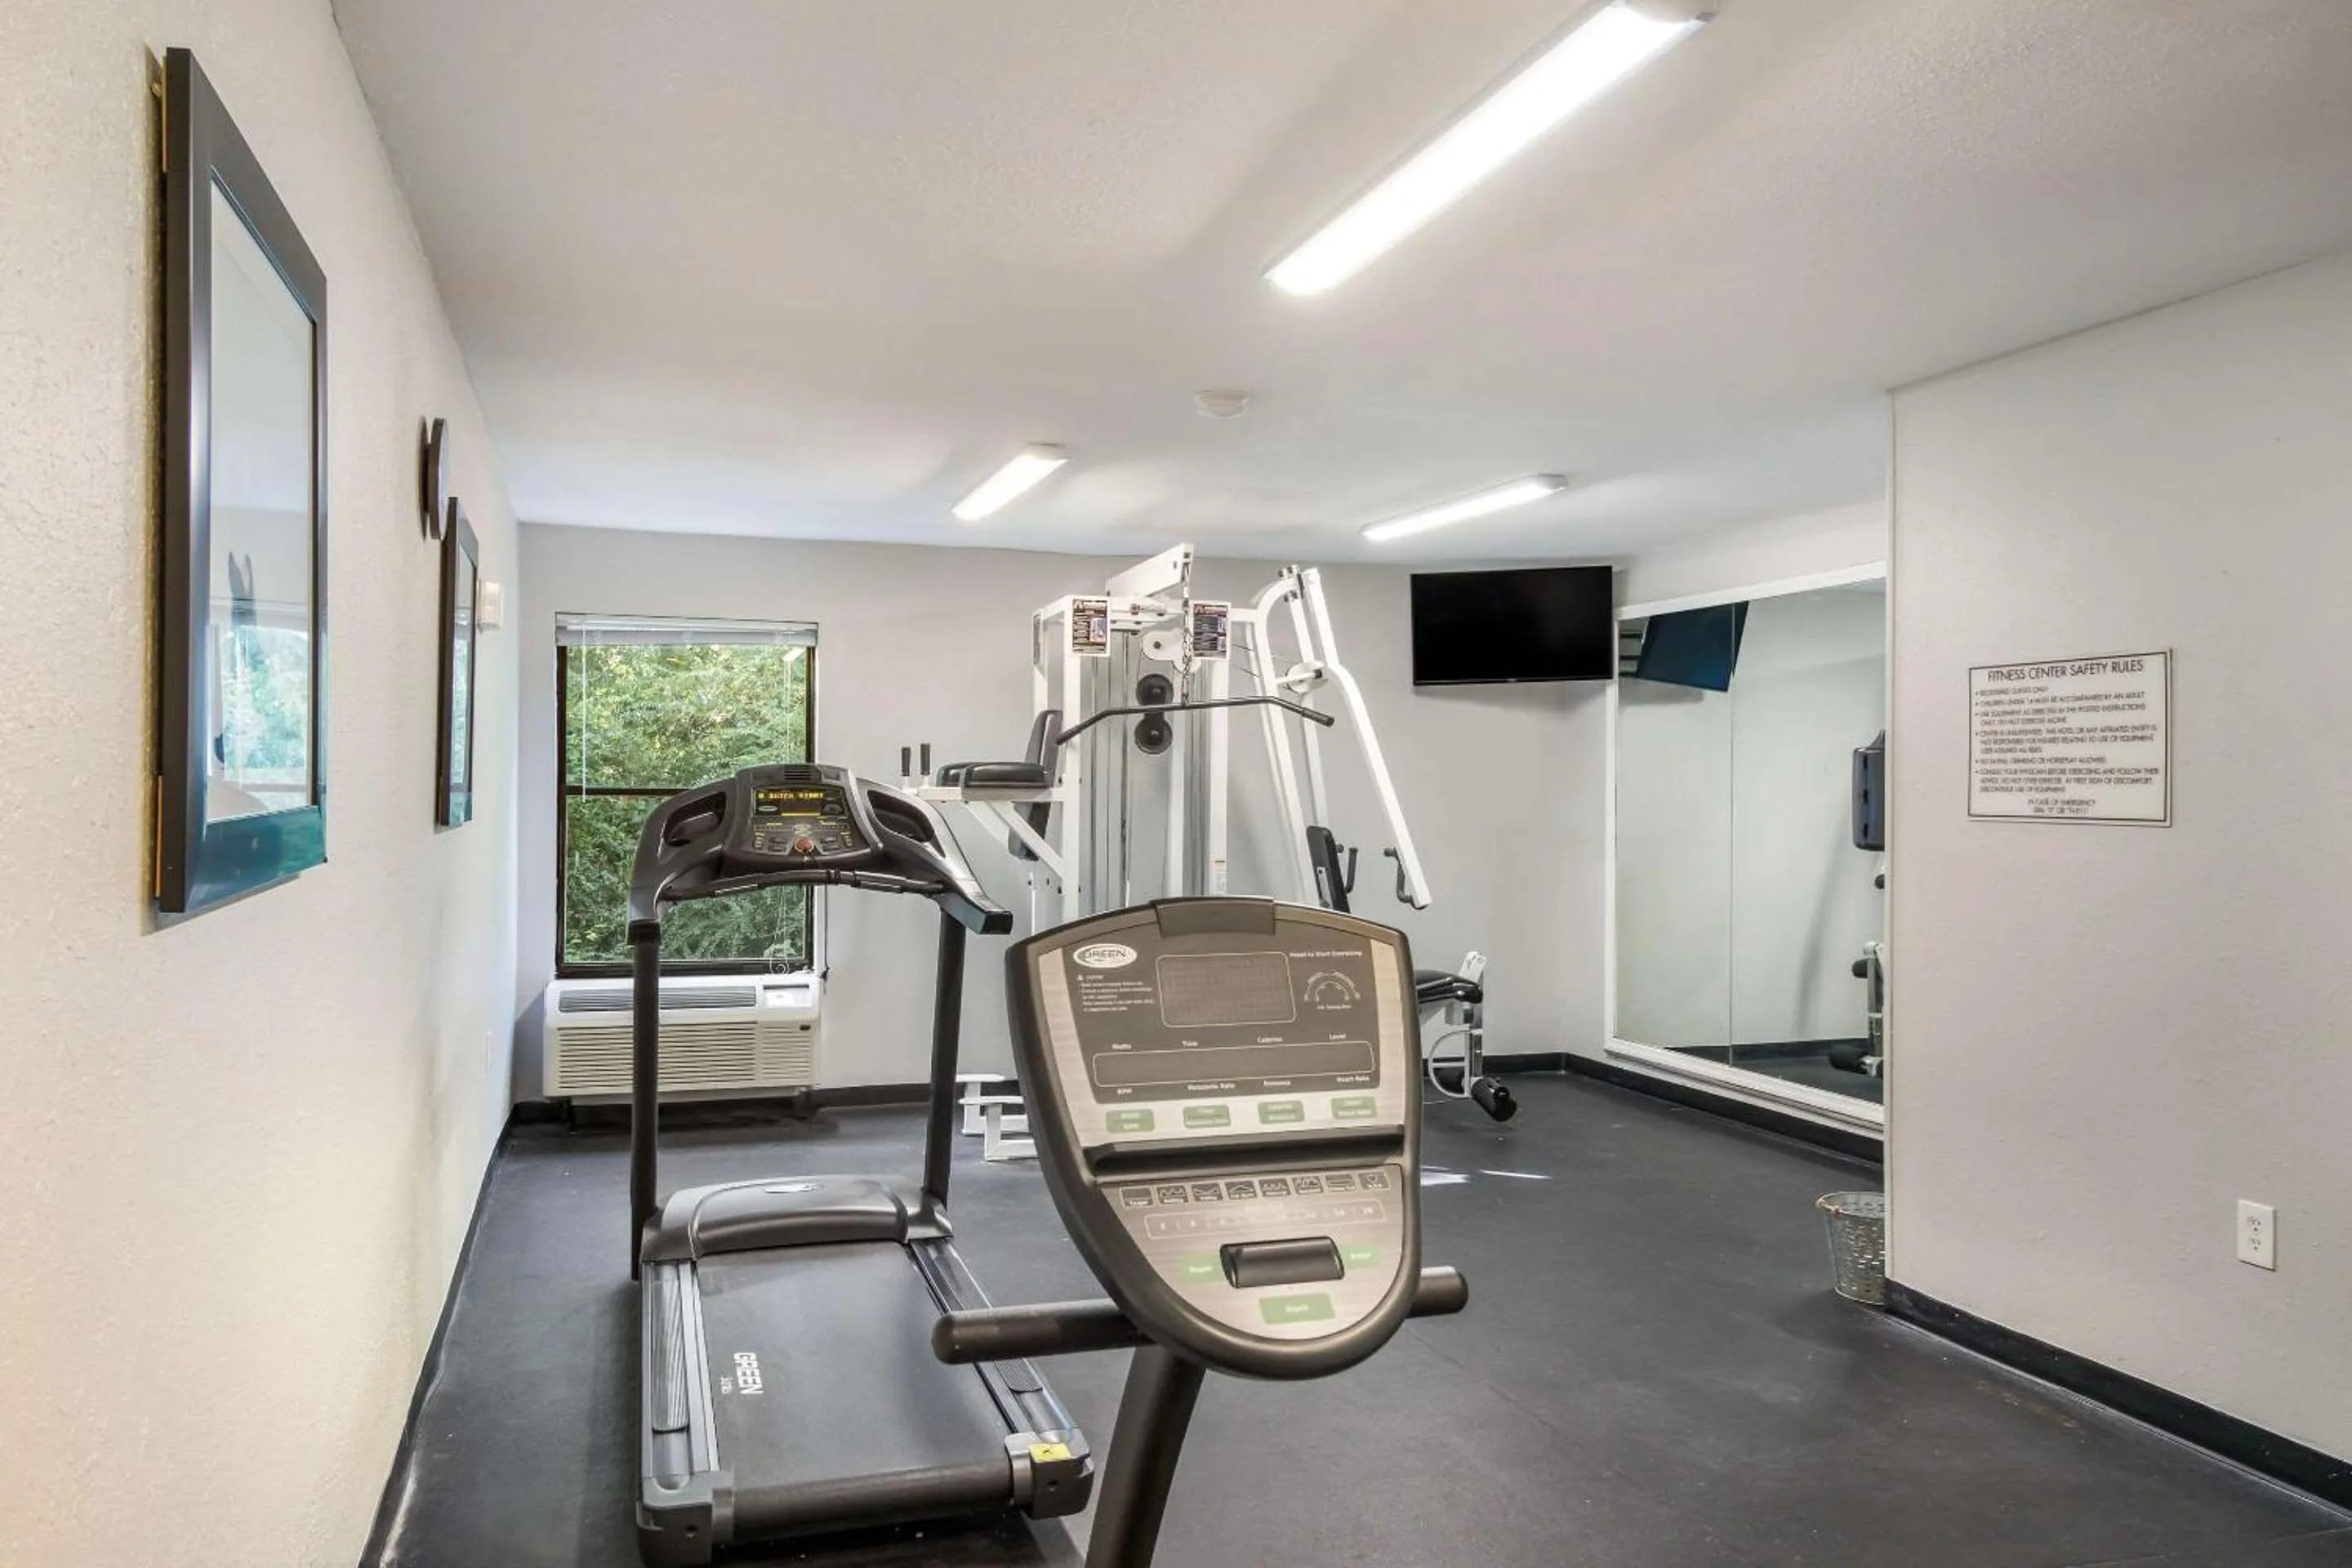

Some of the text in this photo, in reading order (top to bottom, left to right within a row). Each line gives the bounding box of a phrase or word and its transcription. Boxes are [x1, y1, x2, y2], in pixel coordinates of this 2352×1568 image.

[1988, 660, 2144, 682] FITNESS CENTER SAFETY RULES
[2114, 692, 2123, 700] AN
[2126, 691, 2145, 699] ADULT
[1329, 1032, 1347, 1040] Level
[733, 1352, 764, 1395] GREEN
